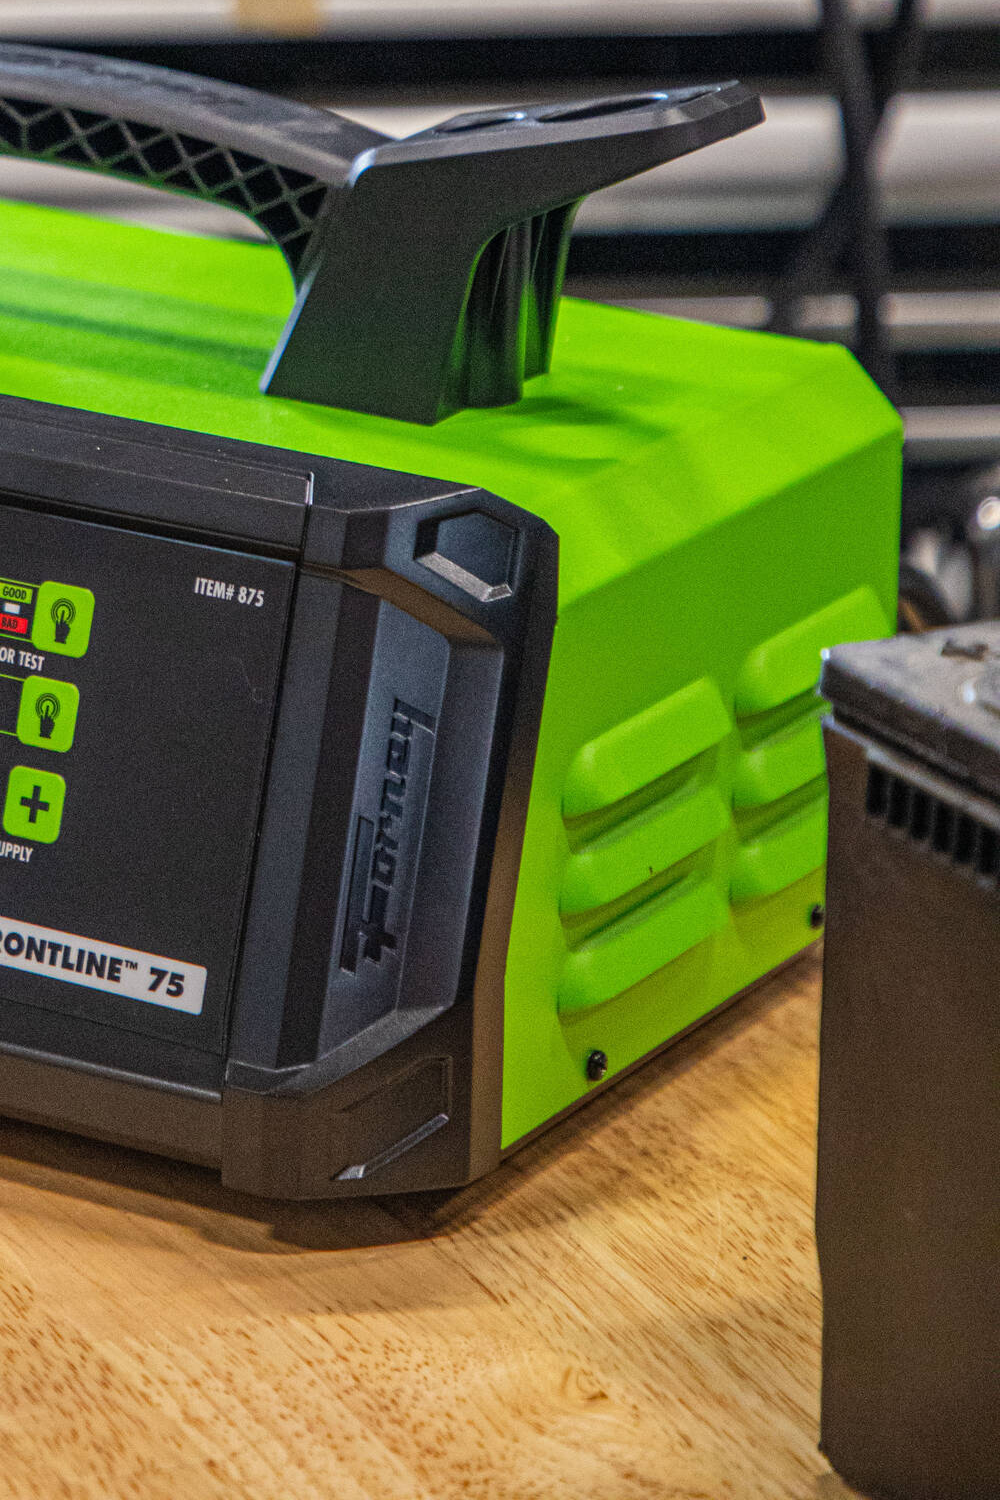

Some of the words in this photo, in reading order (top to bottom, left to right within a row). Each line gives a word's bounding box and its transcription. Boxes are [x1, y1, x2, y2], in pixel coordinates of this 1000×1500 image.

[2, 586, 27, 600] GOOD
[194, 576, 235, 600] ITEM#
[238, 586, 265, 607] 875
[2, 616, 18, 629] BAD
[19, 651, 45, 671] TEST
[147, 967, 186, 998] 75
